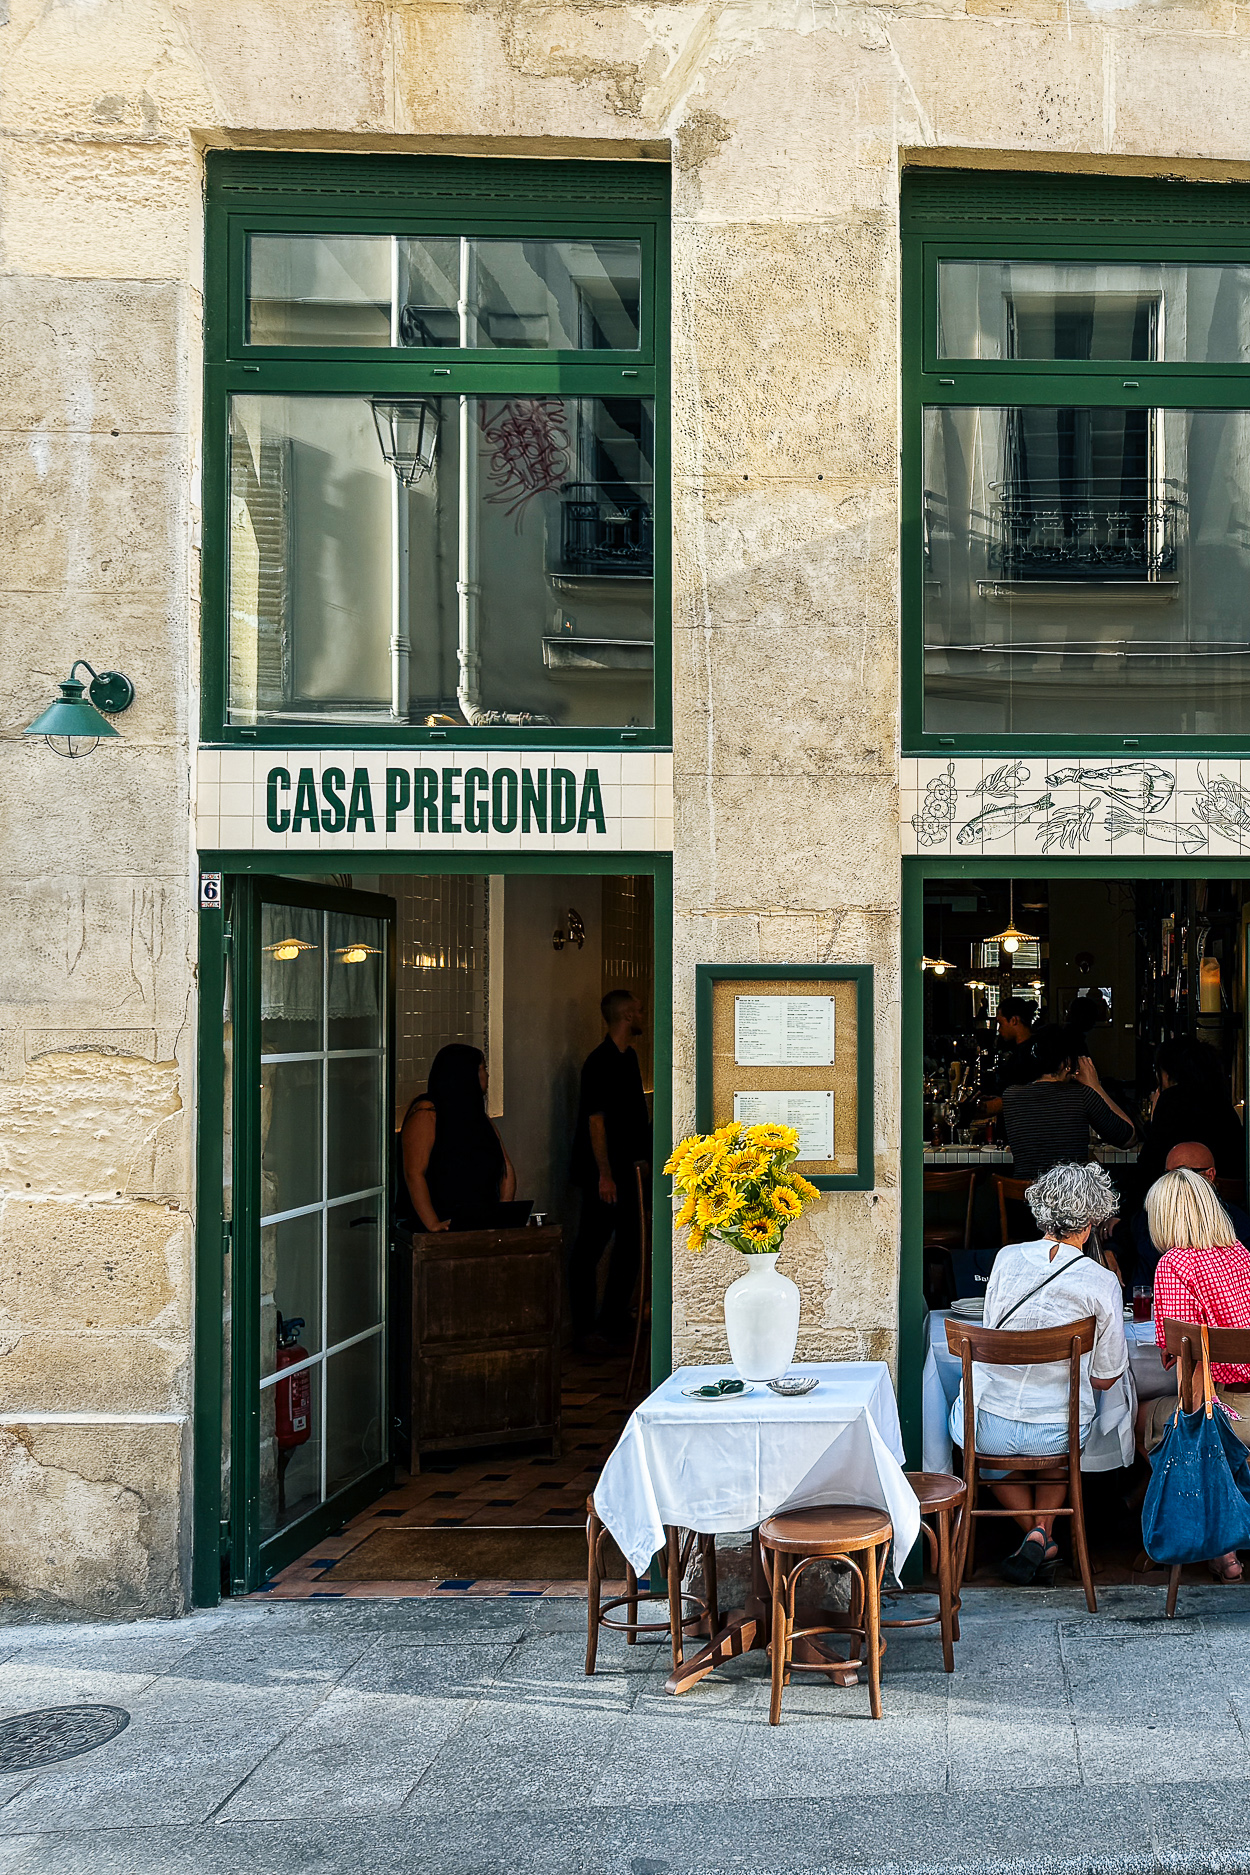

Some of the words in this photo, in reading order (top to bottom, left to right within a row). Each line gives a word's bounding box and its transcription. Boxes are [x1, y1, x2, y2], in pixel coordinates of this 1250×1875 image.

[266, 766, 376, 833] CASA
[385, 767, 607, 834] PREGONDA
[204, 881, 218, 900] 6
